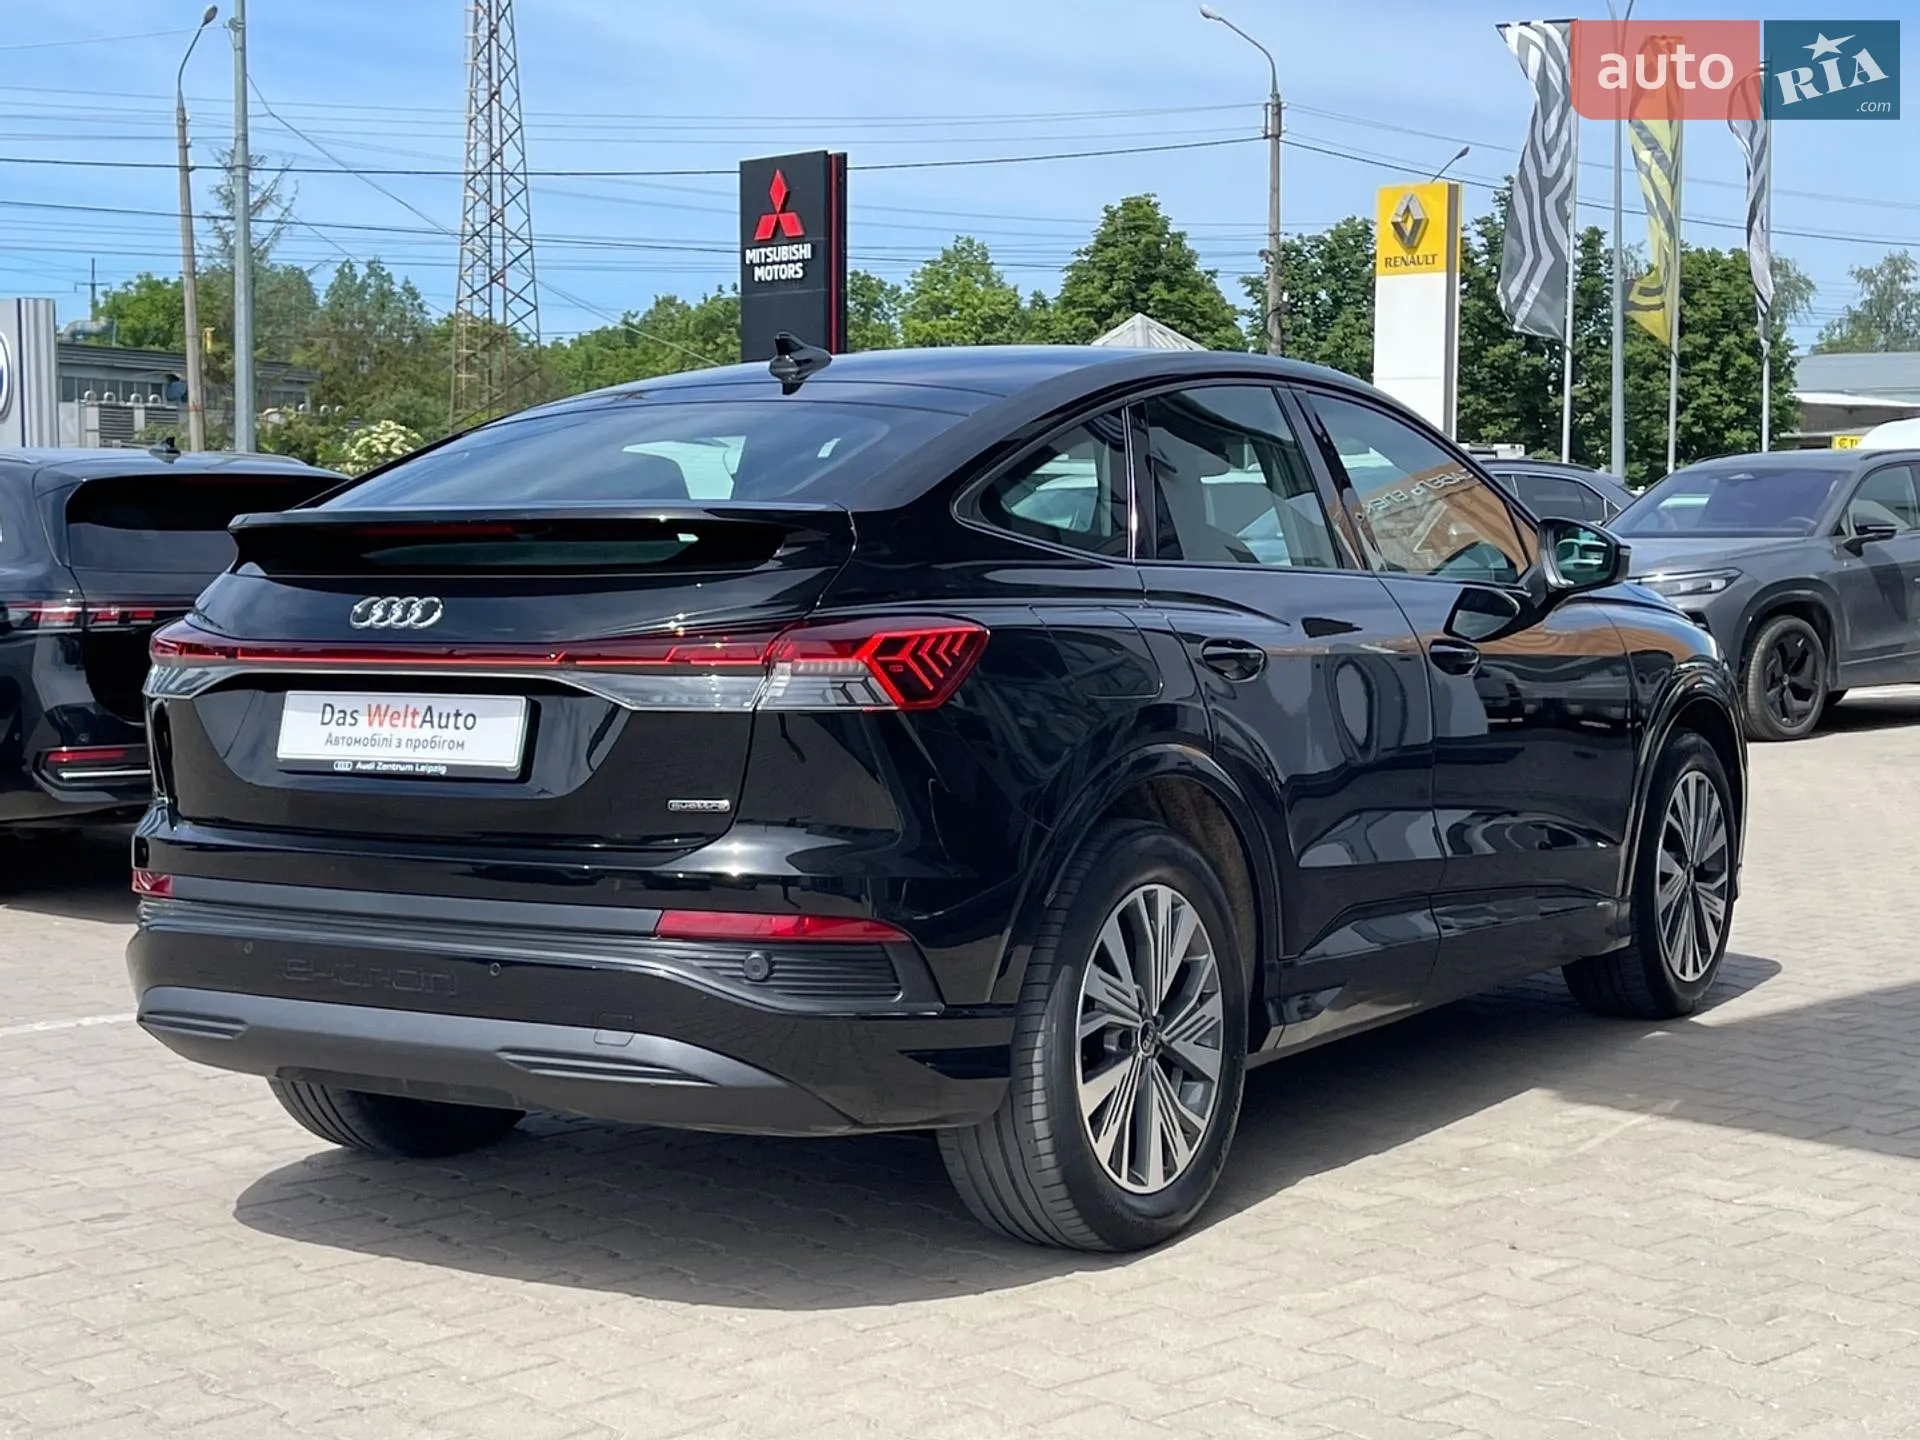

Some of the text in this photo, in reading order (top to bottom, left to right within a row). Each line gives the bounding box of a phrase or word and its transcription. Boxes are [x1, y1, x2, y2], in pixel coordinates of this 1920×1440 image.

[746, 243, 812, 264] MITSUBISHI
[1384, 254, 1438, 268] RENAULT
[754, 263, 804, 282] MOTORS
[320, 703, 477, 730] Das WeltAuto
[325, 732, 393, 748] Автомобілі
[405, 734, 465, 752] пробігом
[355, 762, 447, 774] Audi Zentrum Leipzig
